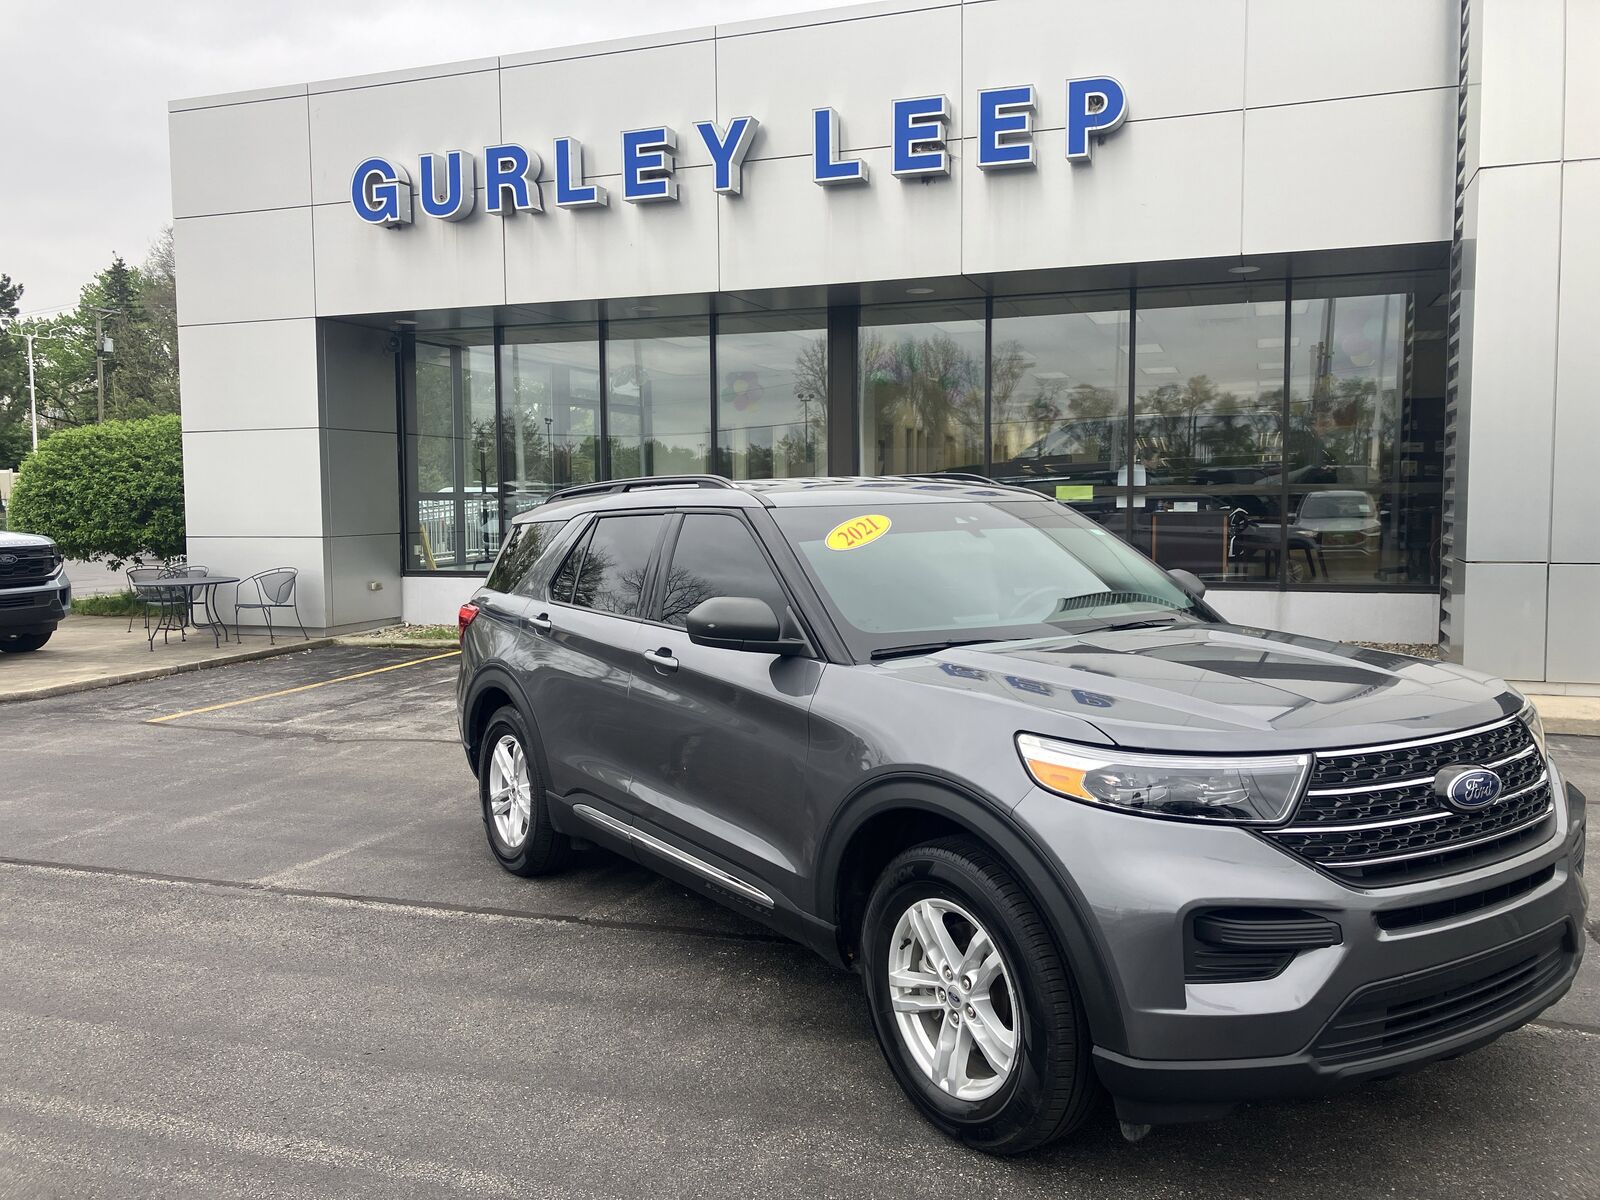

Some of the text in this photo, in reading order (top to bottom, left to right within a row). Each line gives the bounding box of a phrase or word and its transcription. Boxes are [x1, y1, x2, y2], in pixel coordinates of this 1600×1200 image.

[350, 75, 1129, 226] GURLEY LEEP
[837, 517, 881, 546] 2021
[1465, 777, 1494, 801] Ford
